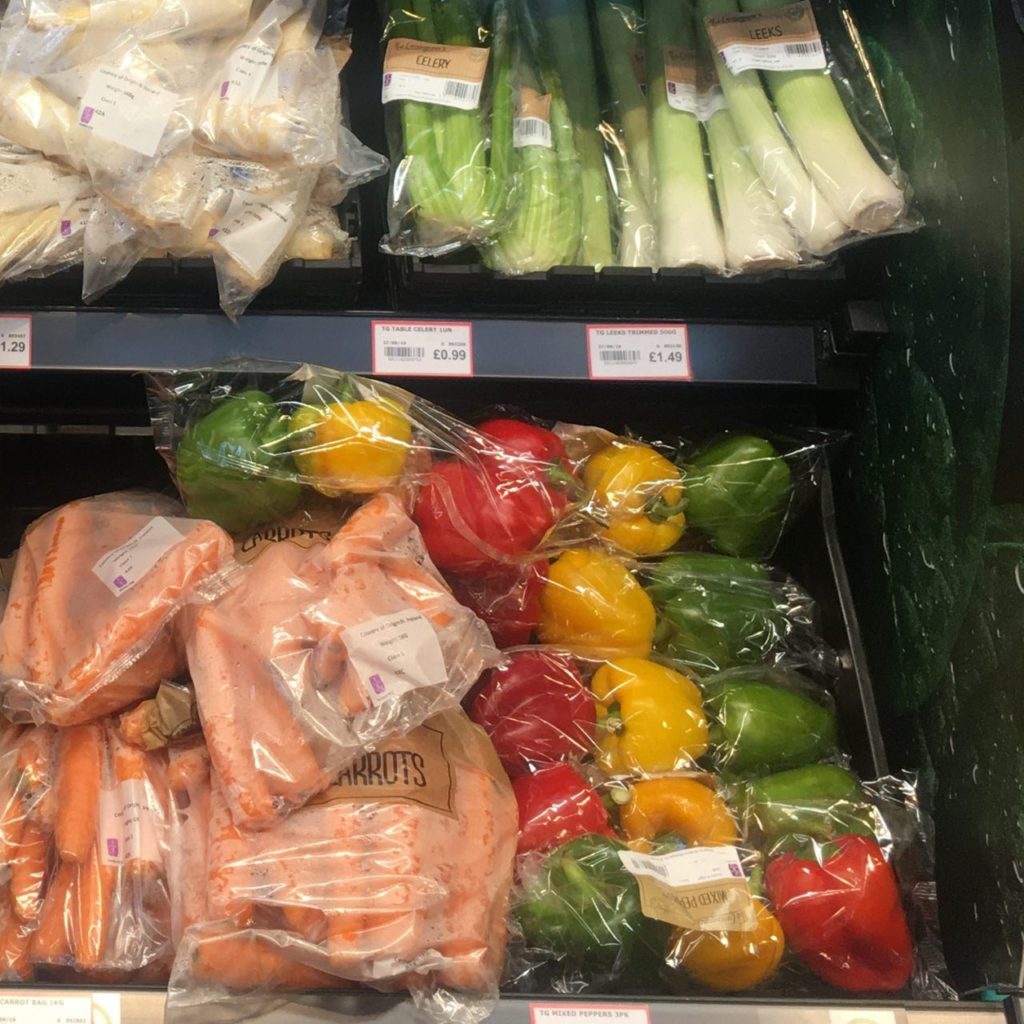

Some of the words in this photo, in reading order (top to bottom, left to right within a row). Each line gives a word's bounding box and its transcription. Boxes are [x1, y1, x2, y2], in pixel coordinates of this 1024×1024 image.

[748, 24, 783, 40] LEEKS
[416, 54, 451, 70] CELERY
[433, 350, 466, 360] £0.99
[649, 352, 682, 362] £1.49
[0, 998, 29, 1006] CARROT
